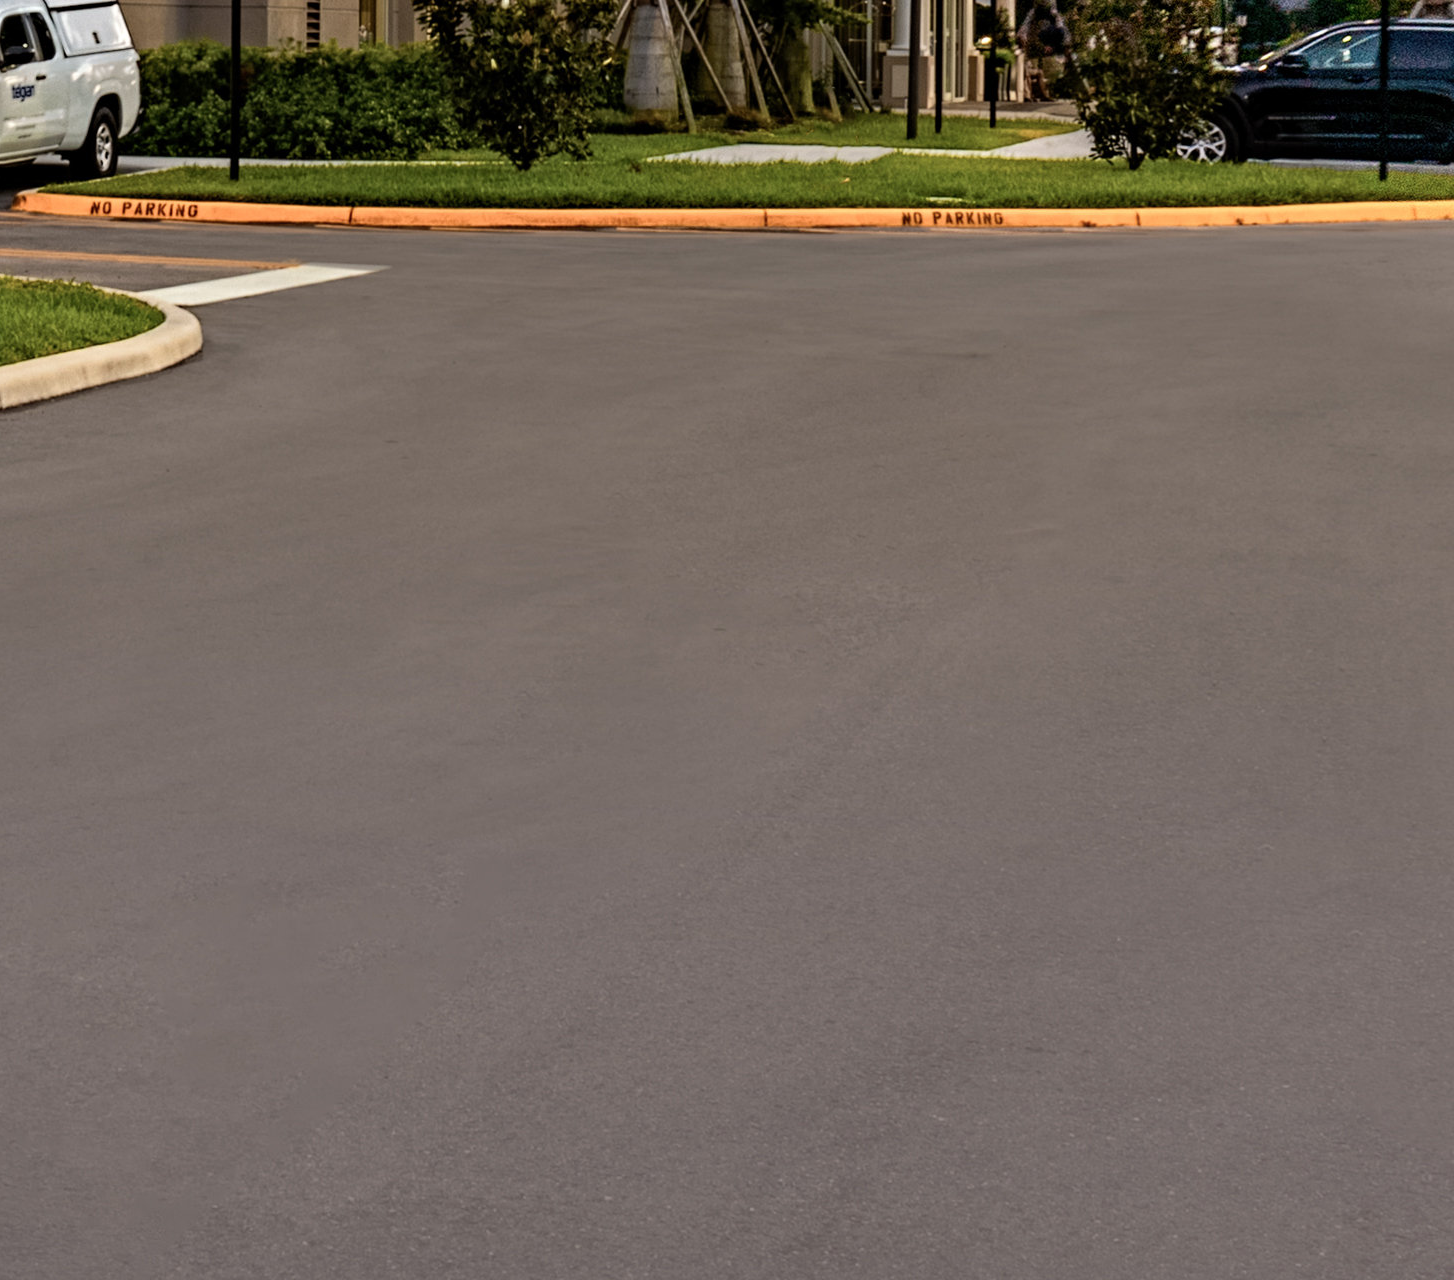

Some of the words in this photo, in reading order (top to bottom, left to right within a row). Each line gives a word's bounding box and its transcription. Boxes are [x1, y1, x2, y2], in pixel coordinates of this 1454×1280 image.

[90, 201, 112, 215] NO
[122, 202, 198, 218] PARKING
[902, 212, 923, 226] NO
[933, 211, 1003, 225] PARKING
